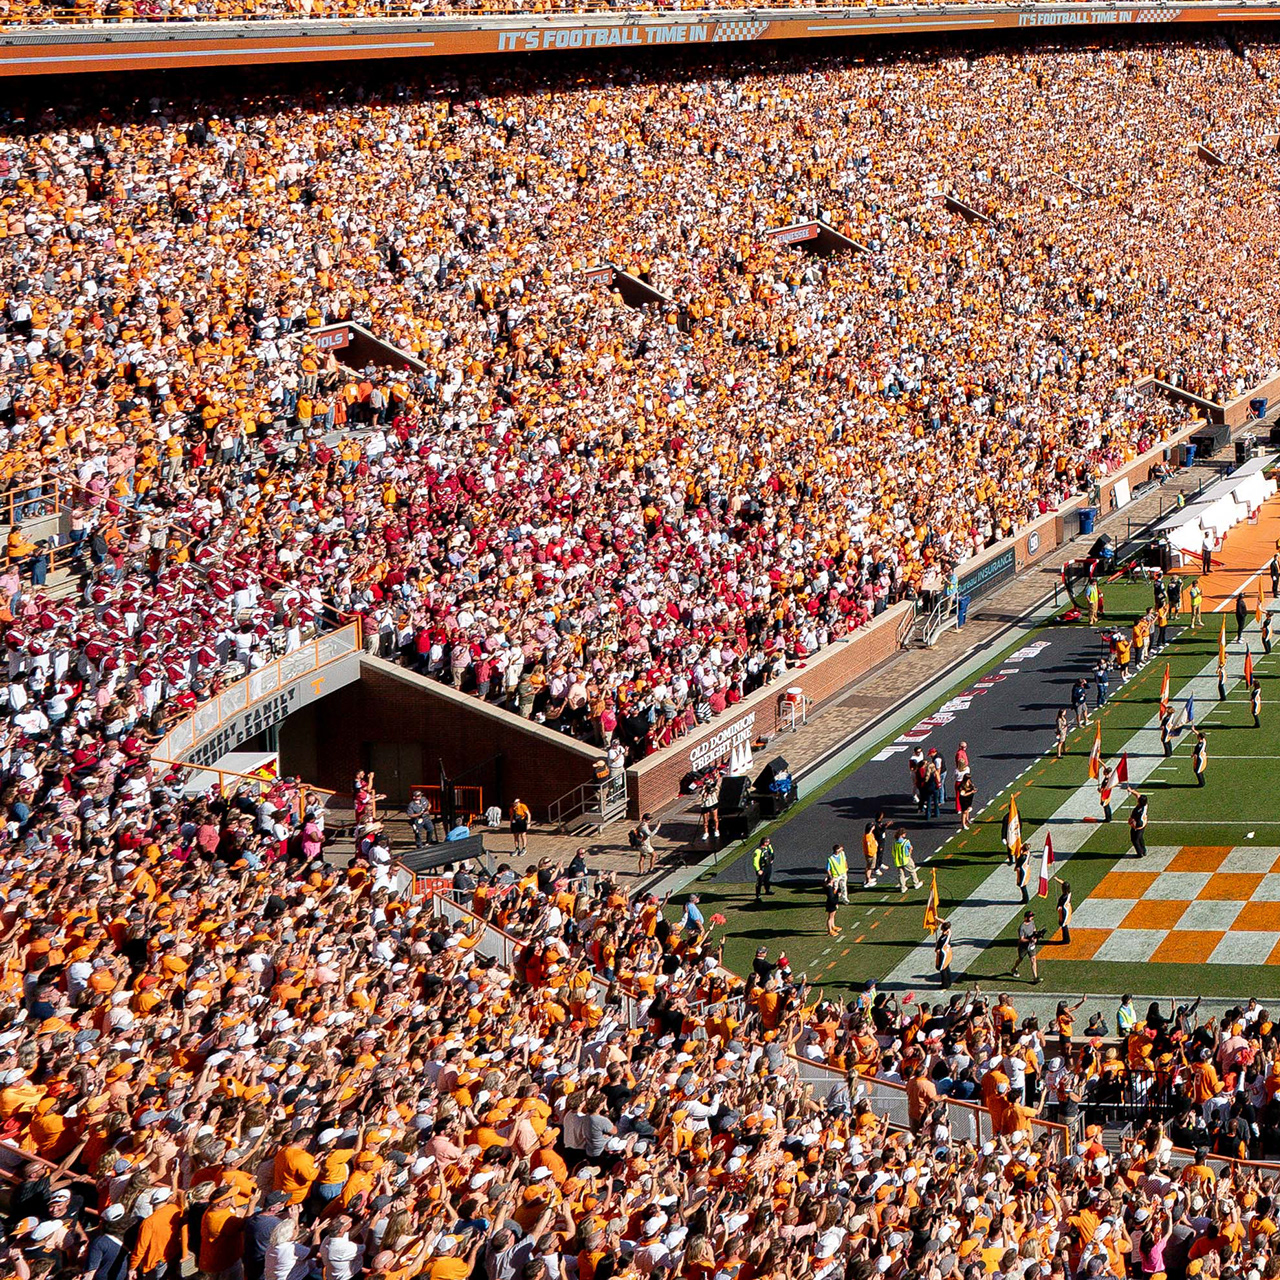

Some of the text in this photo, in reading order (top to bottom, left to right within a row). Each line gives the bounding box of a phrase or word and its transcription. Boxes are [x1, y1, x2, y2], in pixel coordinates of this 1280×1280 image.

[1018, 11, 1132, 26] IT'S FOOTBALL TIME IN
[498, 26, 707, 50] IT'S FOOTBALL TIME IN
[977, 552, 1014, 581] INSURANCE
[311, 677, 325, 695] T
[188, 687, 296, 764] STOKELY FAMILY
[236, 705, 289, 744] CENTER
[690, 711, 756, 762] OLD DOMINION
[692, 724, 754, 771] FREIGHT LINE
